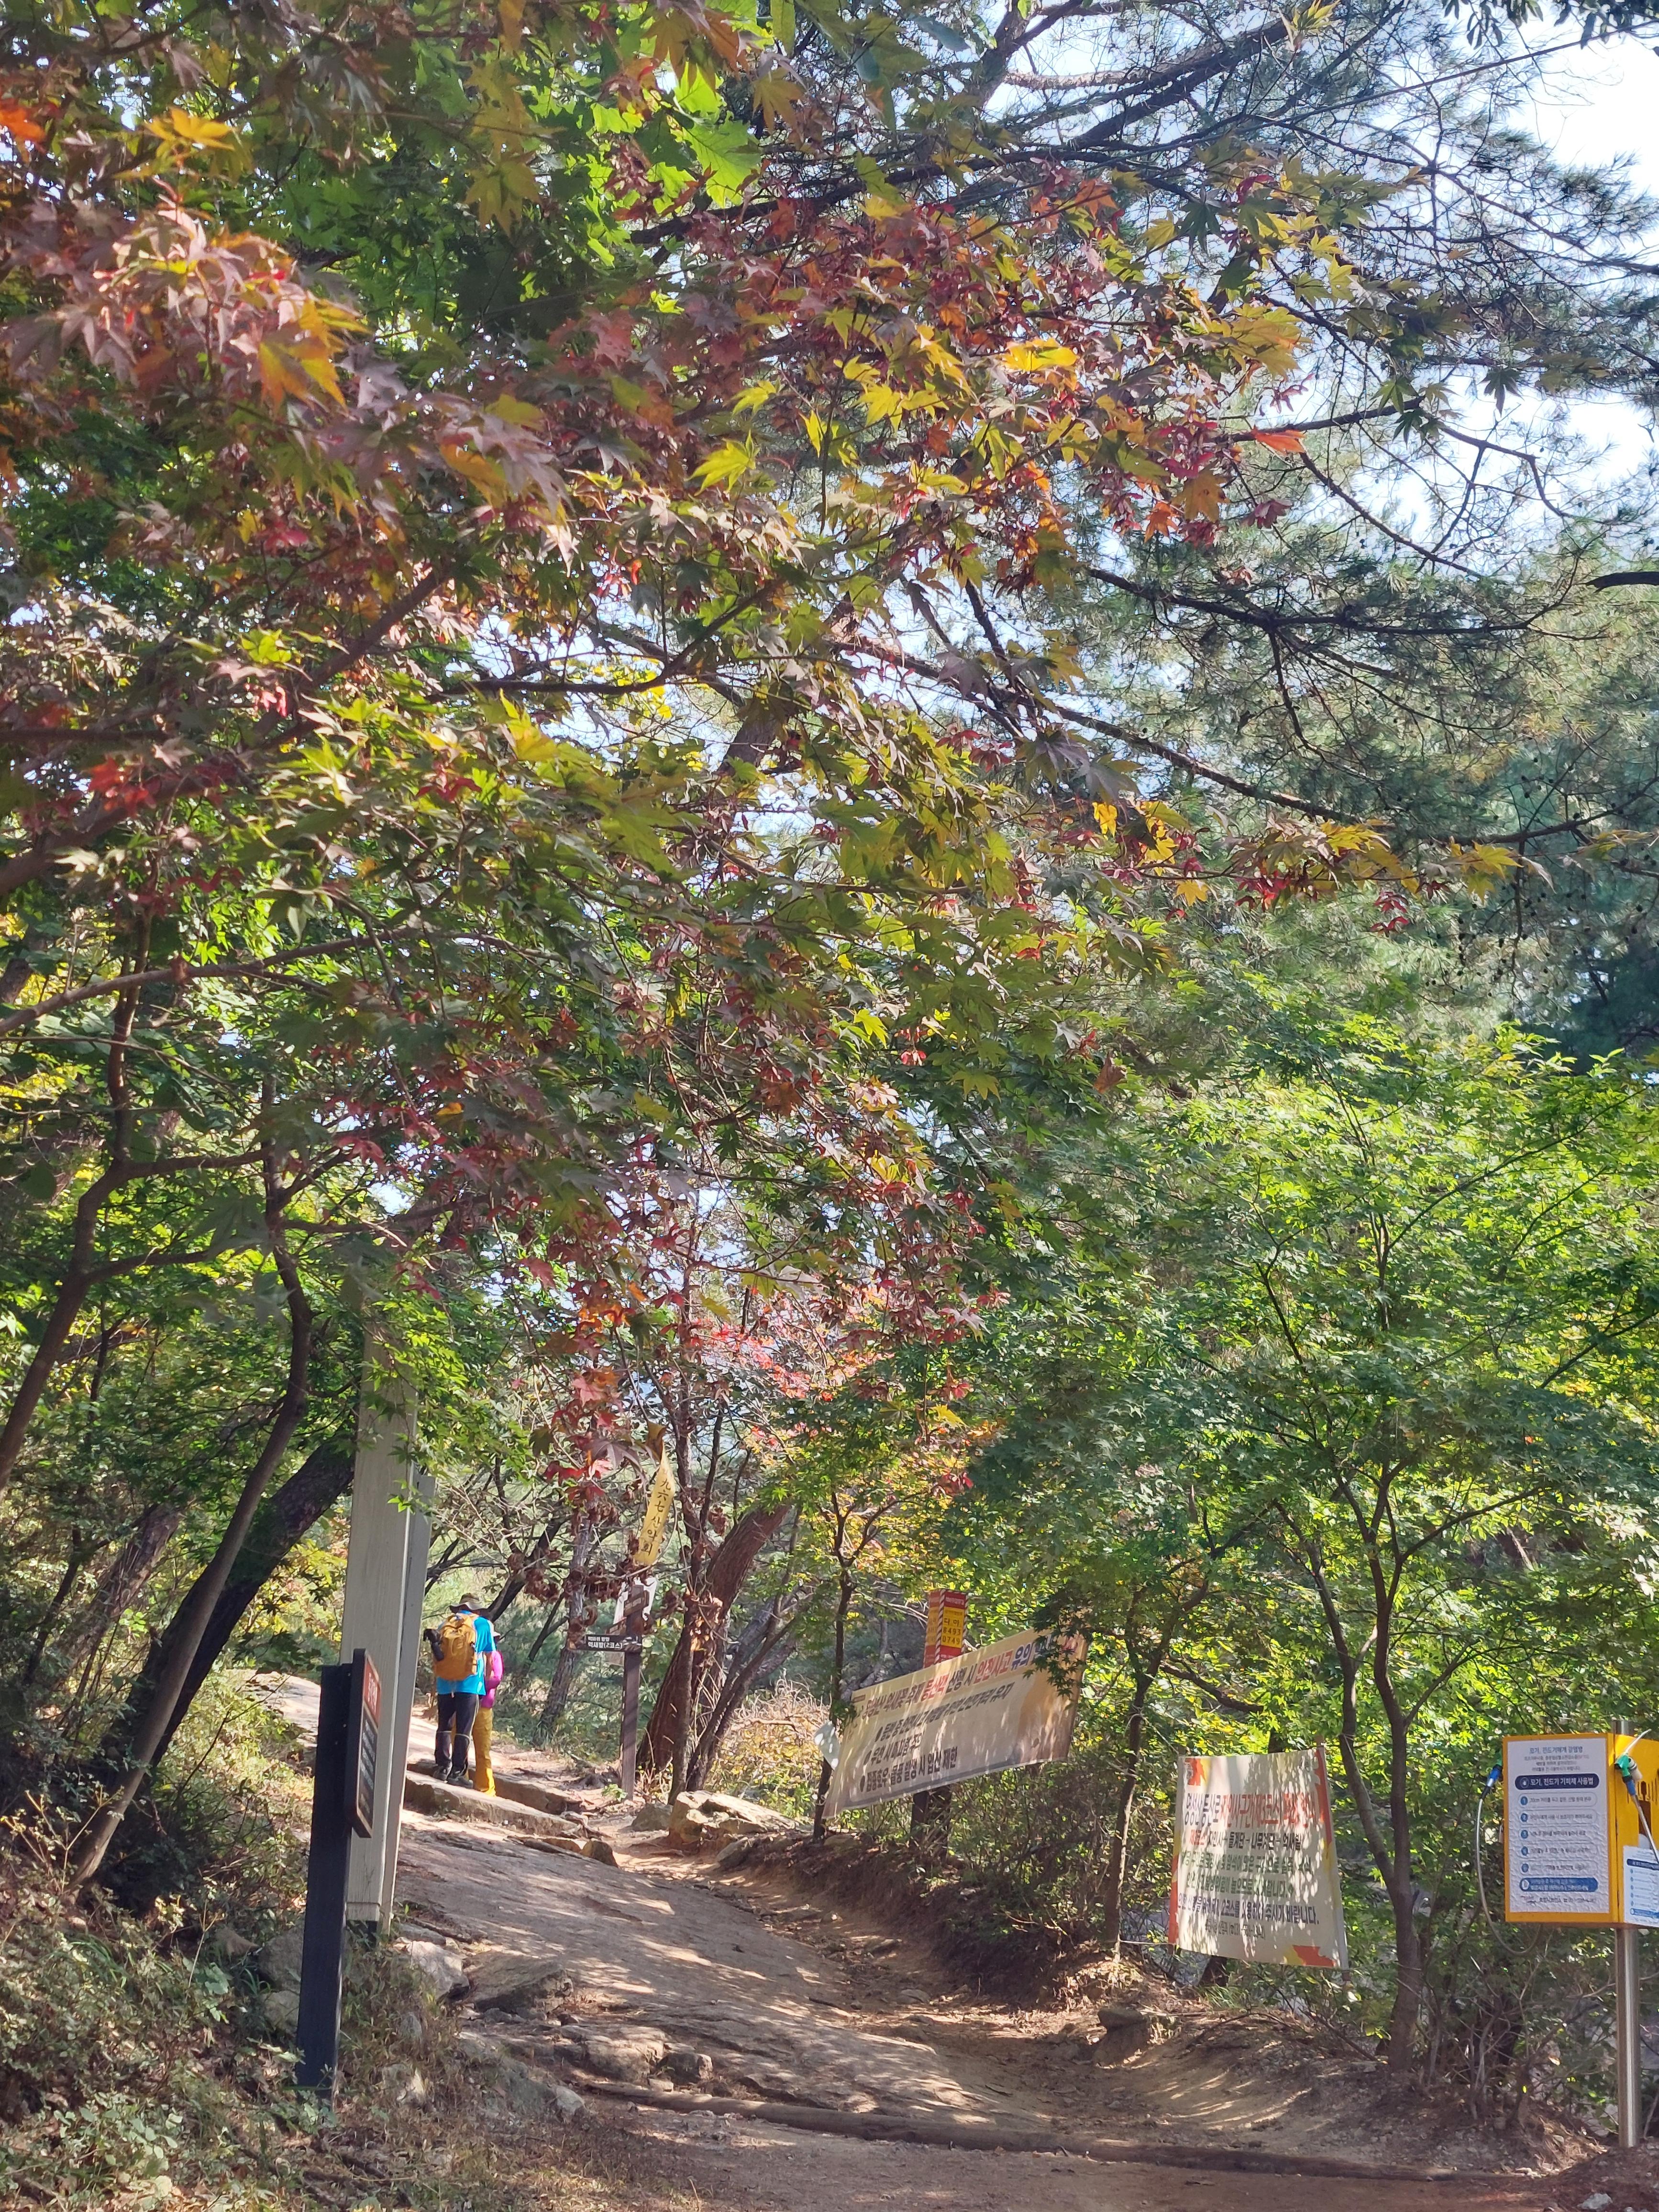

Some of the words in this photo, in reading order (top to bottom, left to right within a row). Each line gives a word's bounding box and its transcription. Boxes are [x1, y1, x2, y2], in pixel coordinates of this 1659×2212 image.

[942, 1627, 961, 1636] 8493
[942, 1636, 960, 1645] 0749
[921, 1675, 949, 1702] 등산객
[946, 1667, 967, 1693] 산행
[964, 1663, 977, 1686] 시
[973, 1650, 1014, 1684] 안전사고
[1011, 1643, 1032, 1670] 유의
[918, 1754, 926, 1776] 시
[927, 1750, 941, 1775] 입산
[1577, 1777, 1593, 1785] 사용법
[1184, 1793, 1202, 1825] 명성산
[1201, 1794, 1220, 1826] 등산로
[1251, 1832, 1275, 1850] 나무계단
[1265, 1904, 1284, 1923] 주시기
[1286, 1904, 1319, 1925] 바랍니다.
